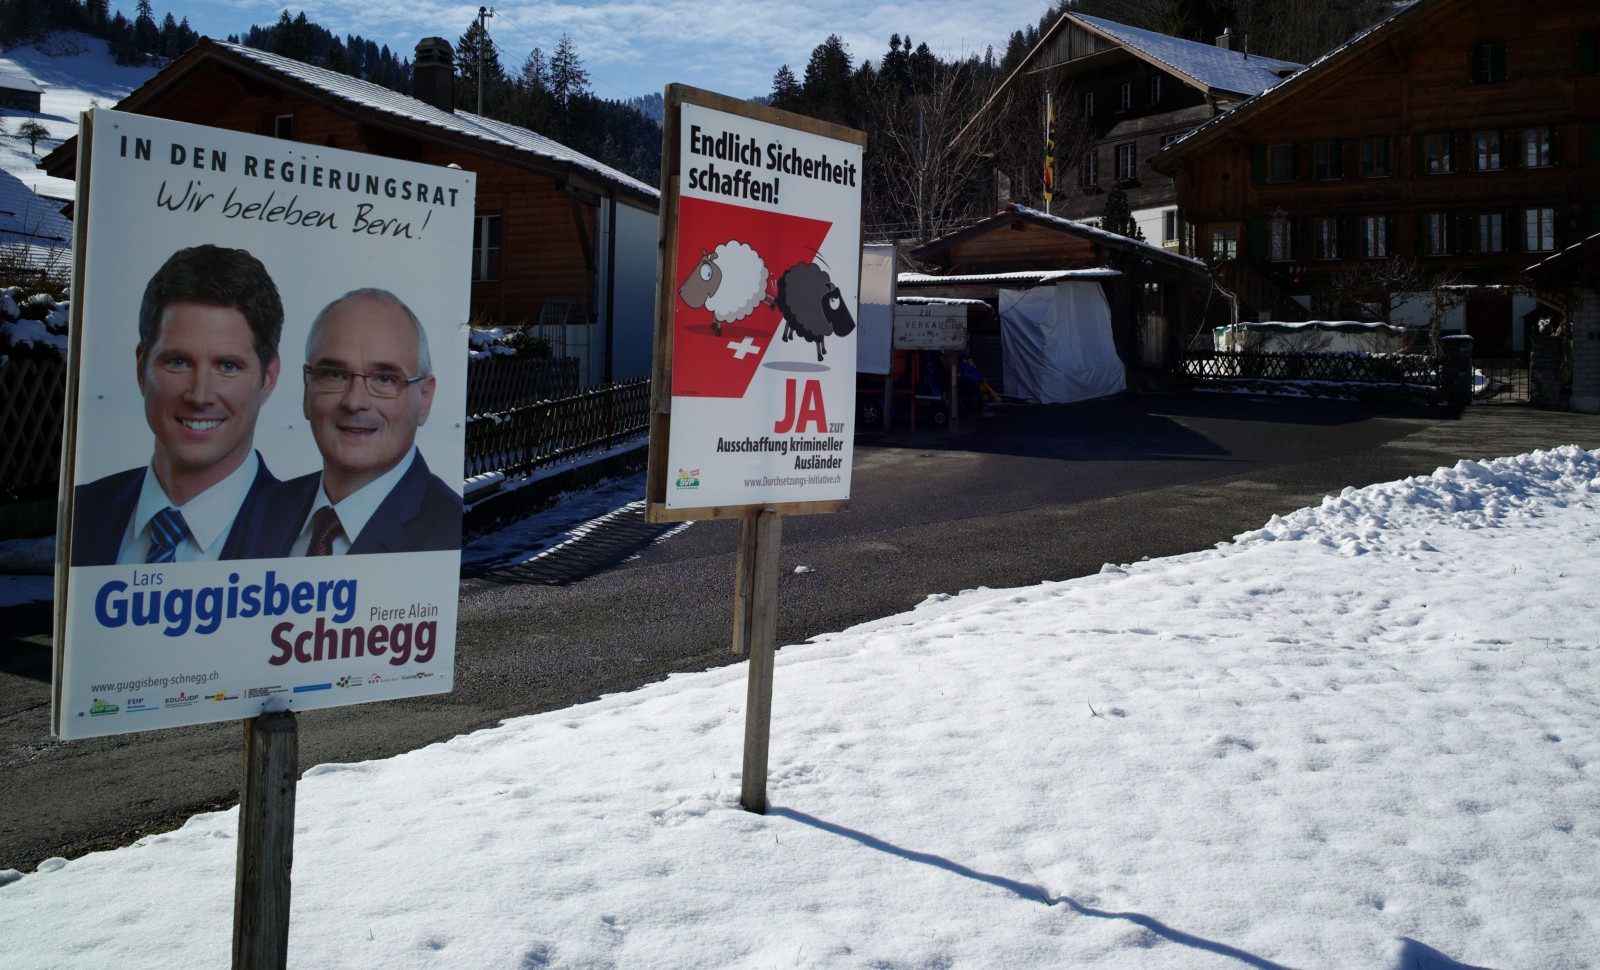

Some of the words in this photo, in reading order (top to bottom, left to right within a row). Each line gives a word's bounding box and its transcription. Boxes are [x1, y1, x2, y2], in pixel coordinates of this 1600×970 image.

[690, 124, 761, 168] Endlich
[766, 143, 857, 187] Sicherheit
[119, 135, 152, 161] IN
[170, 143, 227, 172] DEN
[244, 154, 459, 207] REGIERUNGSRAT
[688, 163, 780, 205] schaffen!
[156, 180, 214, 213] Wir
[221, 187, 338, 230] beleben
[352, 202, 433, 240] Bern!
[919, 309, 931, 317] ZU
[774, 378, 828, 434] JA
[829, 422, 845, 434] zur
[716, 436, 788, 455] Ausschaffung
[789, 437, 843, 452] krimineller
[794, 454, 843, 470] Ausländer
[744, 474, 841, 488] www.Durchsetzungs-Initiative.ch
[133, 570, 163, 587] Lars
[94, 570, 358, 637] Guggisberg
[370, 606, 406, 622] Pierre
[408, 602, 438, 619] Alain
[267, 617, 437, 666] Schnegg
[91, 670, 219, 693] www.guggisberg-schnegg.ch
[127, 697, 144, 705] FDP
